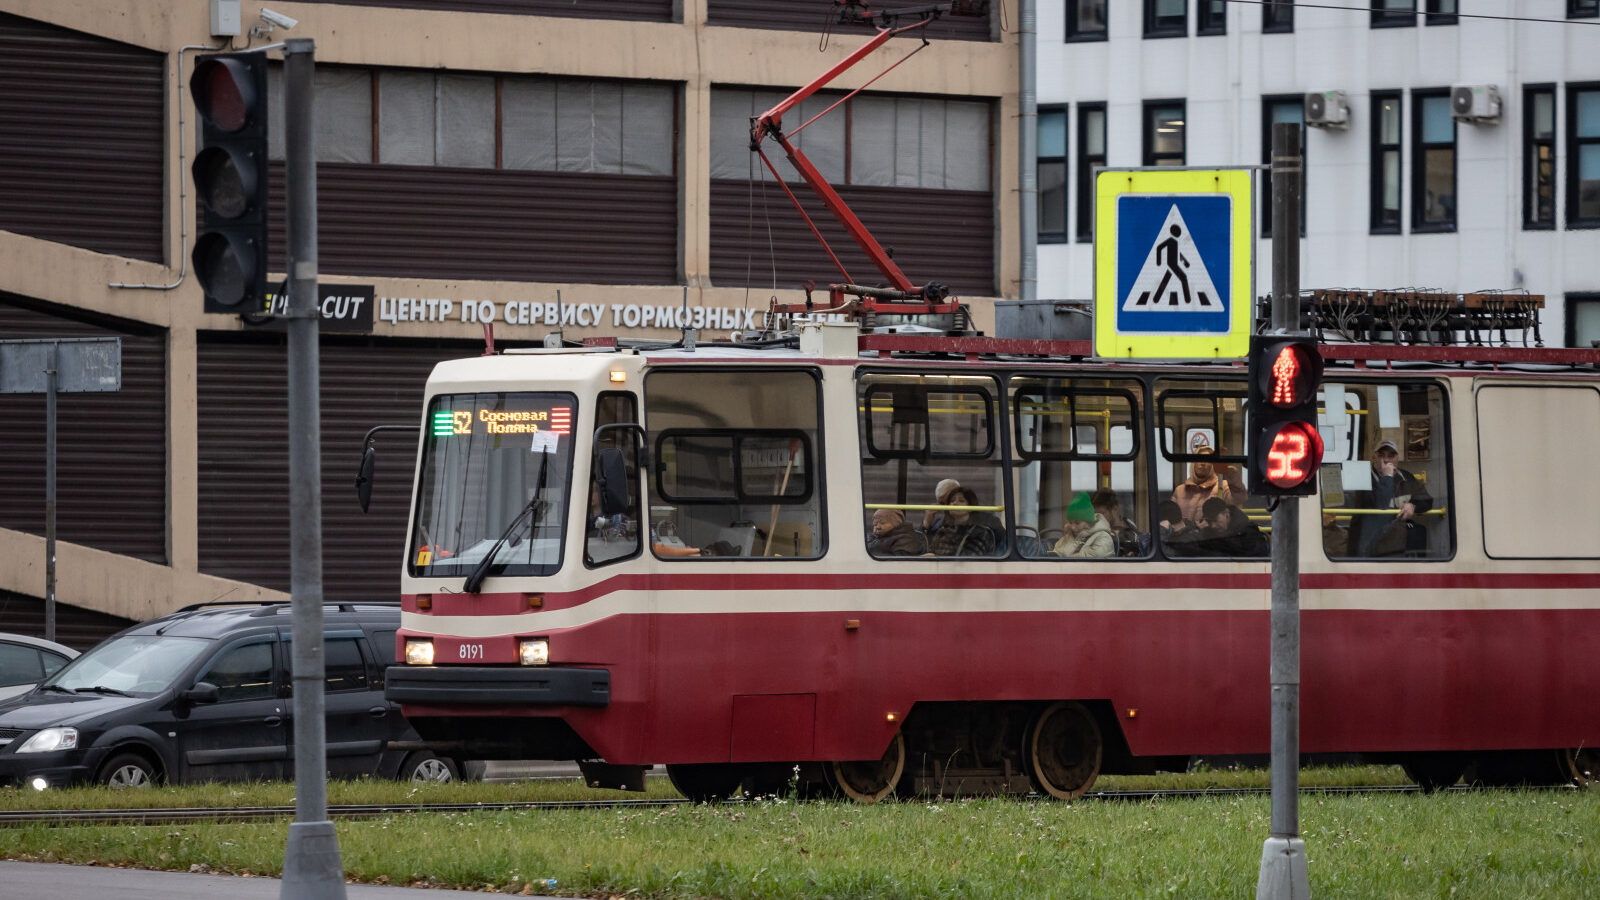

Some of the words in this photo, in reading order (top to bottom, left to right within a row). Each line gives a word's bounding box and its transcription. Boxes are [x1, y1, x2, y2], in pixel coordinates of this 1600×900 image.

[380, 297, 453, 325] ЦЕНТР
[461, 299, 496, 324] ПО
[504, 300, 606, 327] СЕРВИСУ
[611, 303, 756, 330] ТОРМОЗНЫХ
[453, 411, 472, 434] 52
[479, 409, 548, 422] Сосновая
[487, 421, 539, 434] Поляна
[459, 644, 484, 659] 8191
